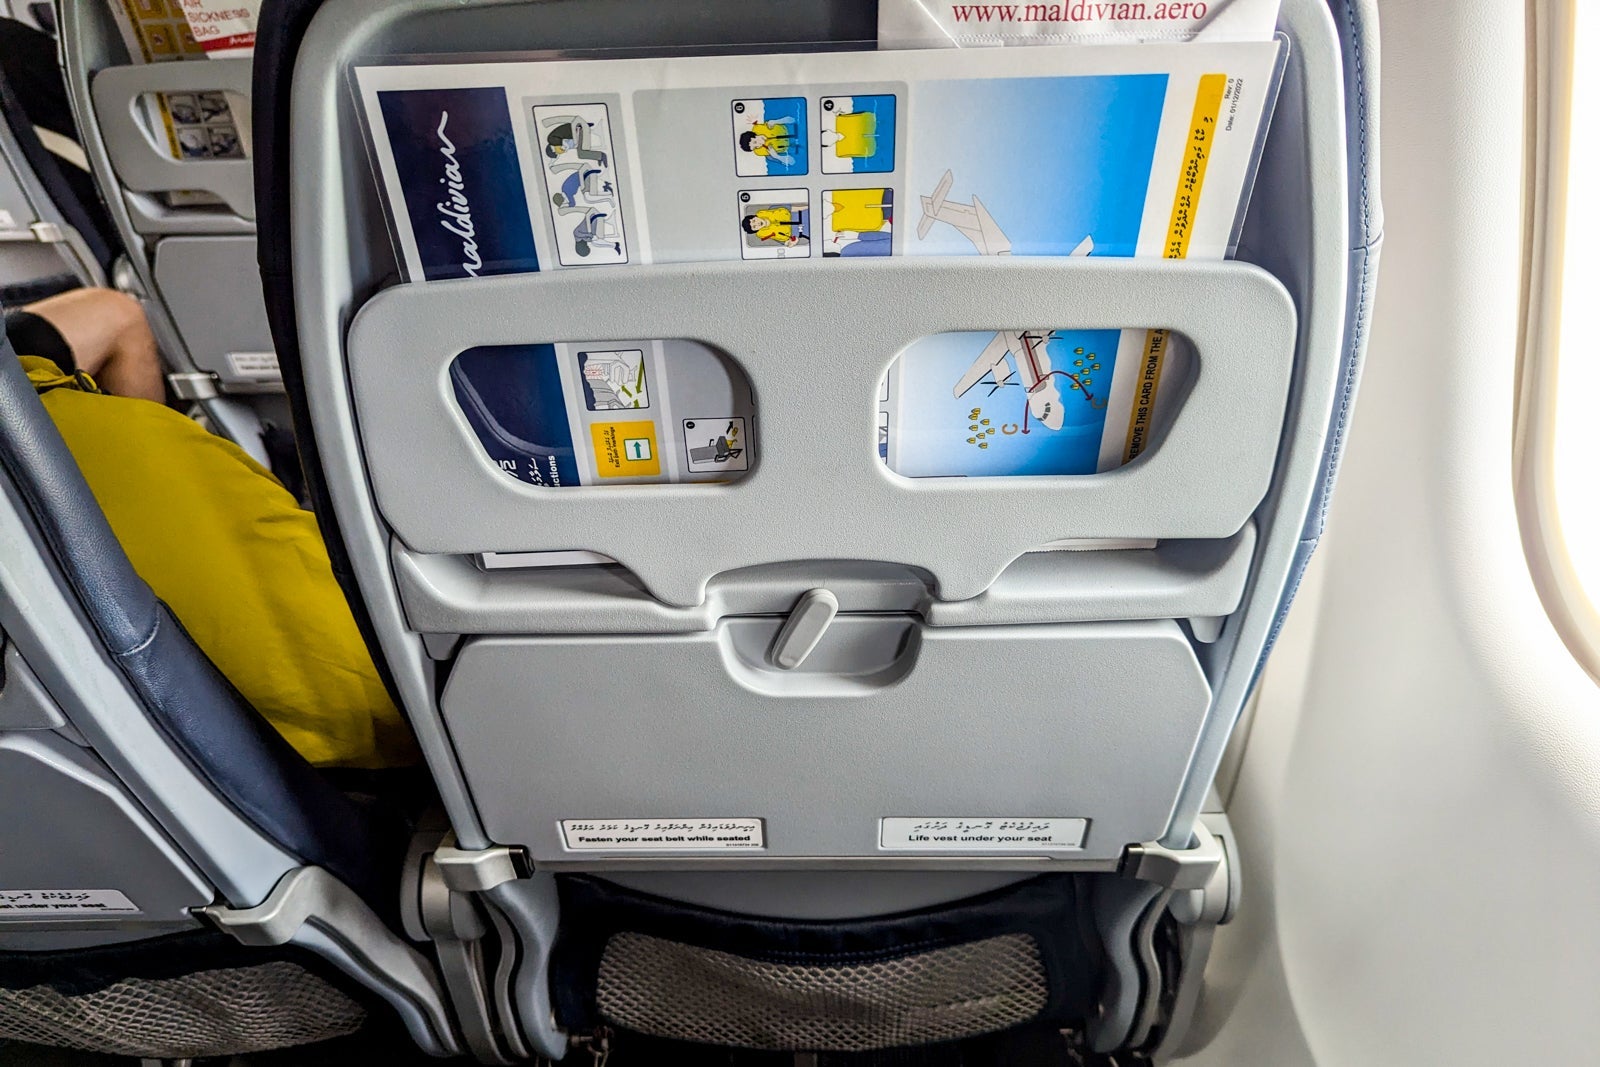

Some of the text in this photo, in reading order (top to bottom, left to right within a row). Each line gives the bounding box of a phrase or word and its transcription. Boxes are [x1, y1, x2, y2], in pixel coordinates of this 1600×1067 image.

[187, 8, 250, 23] SICKNESS
[952, 0, 1208, 22] www.maldivian.aero
[193, 25, 221, 37] BAG
[1225, 114, 1235, 132] Date:
[1150, 336, 1162, 354] THE
[1145, 355, 1158, 380] FROM
[1140, 382, 1153, 405] CARD
[1136, 407, 1148, 425] THIS
[1129, 426, 1144, 459] REMOVE
[615, 836, 639, 844] your
[908, 834, 930, 842] Life
[960, 834, 994, 842] under
[997, 836, 1025, 844] your
